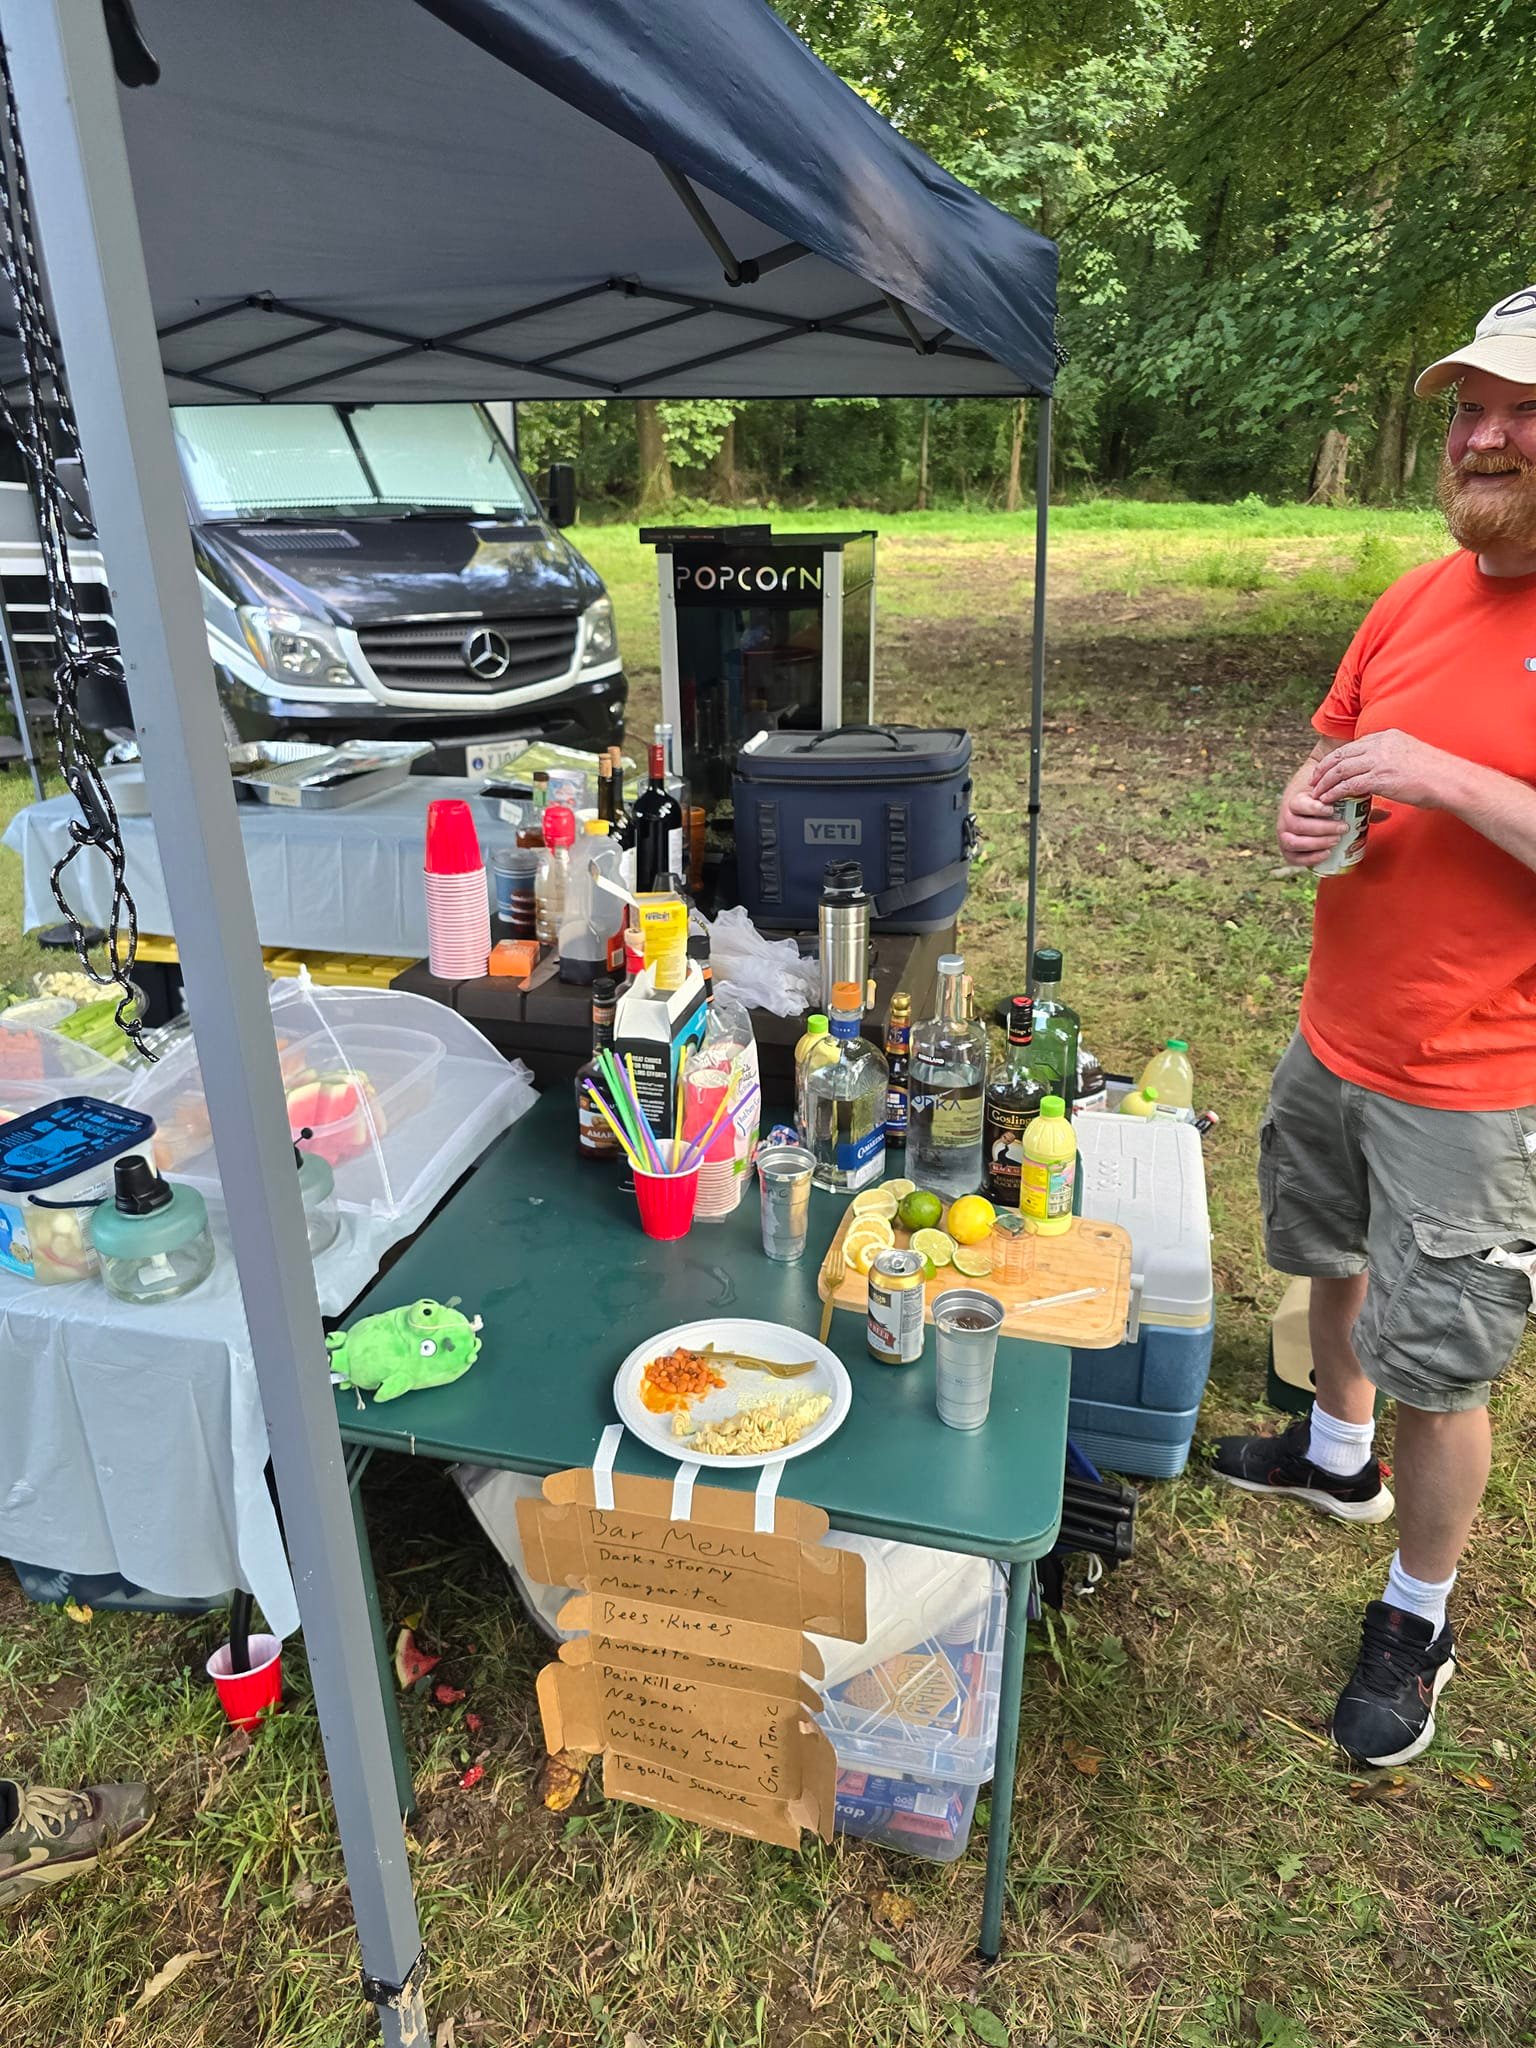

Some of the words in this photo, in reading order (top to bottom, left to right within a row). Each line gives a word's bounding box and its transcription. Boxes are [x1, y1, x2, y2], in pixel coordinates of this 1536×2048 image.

[676, 565, 822, 592] POPCORN
[808, 823, 857, 840] YETI
[588, 1510, 643, 1540] Bar
[661, 1528, 775, 1567] Menu
[600, 1549, 643, 1564] Dark
[600, 1576, 728, 1607] Margarita
[603, 1601, 649, 1625] Bees
[605, 1687, 697, 1715] Negroni
[607, 1709, 684, 1735] Moscow
[691, 1728, 749, 1750] Mule
[758, 1705, 780, 1749] Tonic
[702, 1750, 751, 1771] Sour
[613, 1754, 681, 1784] Tequila
[688, 1777, 759, 1808] Sunrise
[757, 1765, 780, 1794] Gin
[836, 1800, 866, 1819] rap
